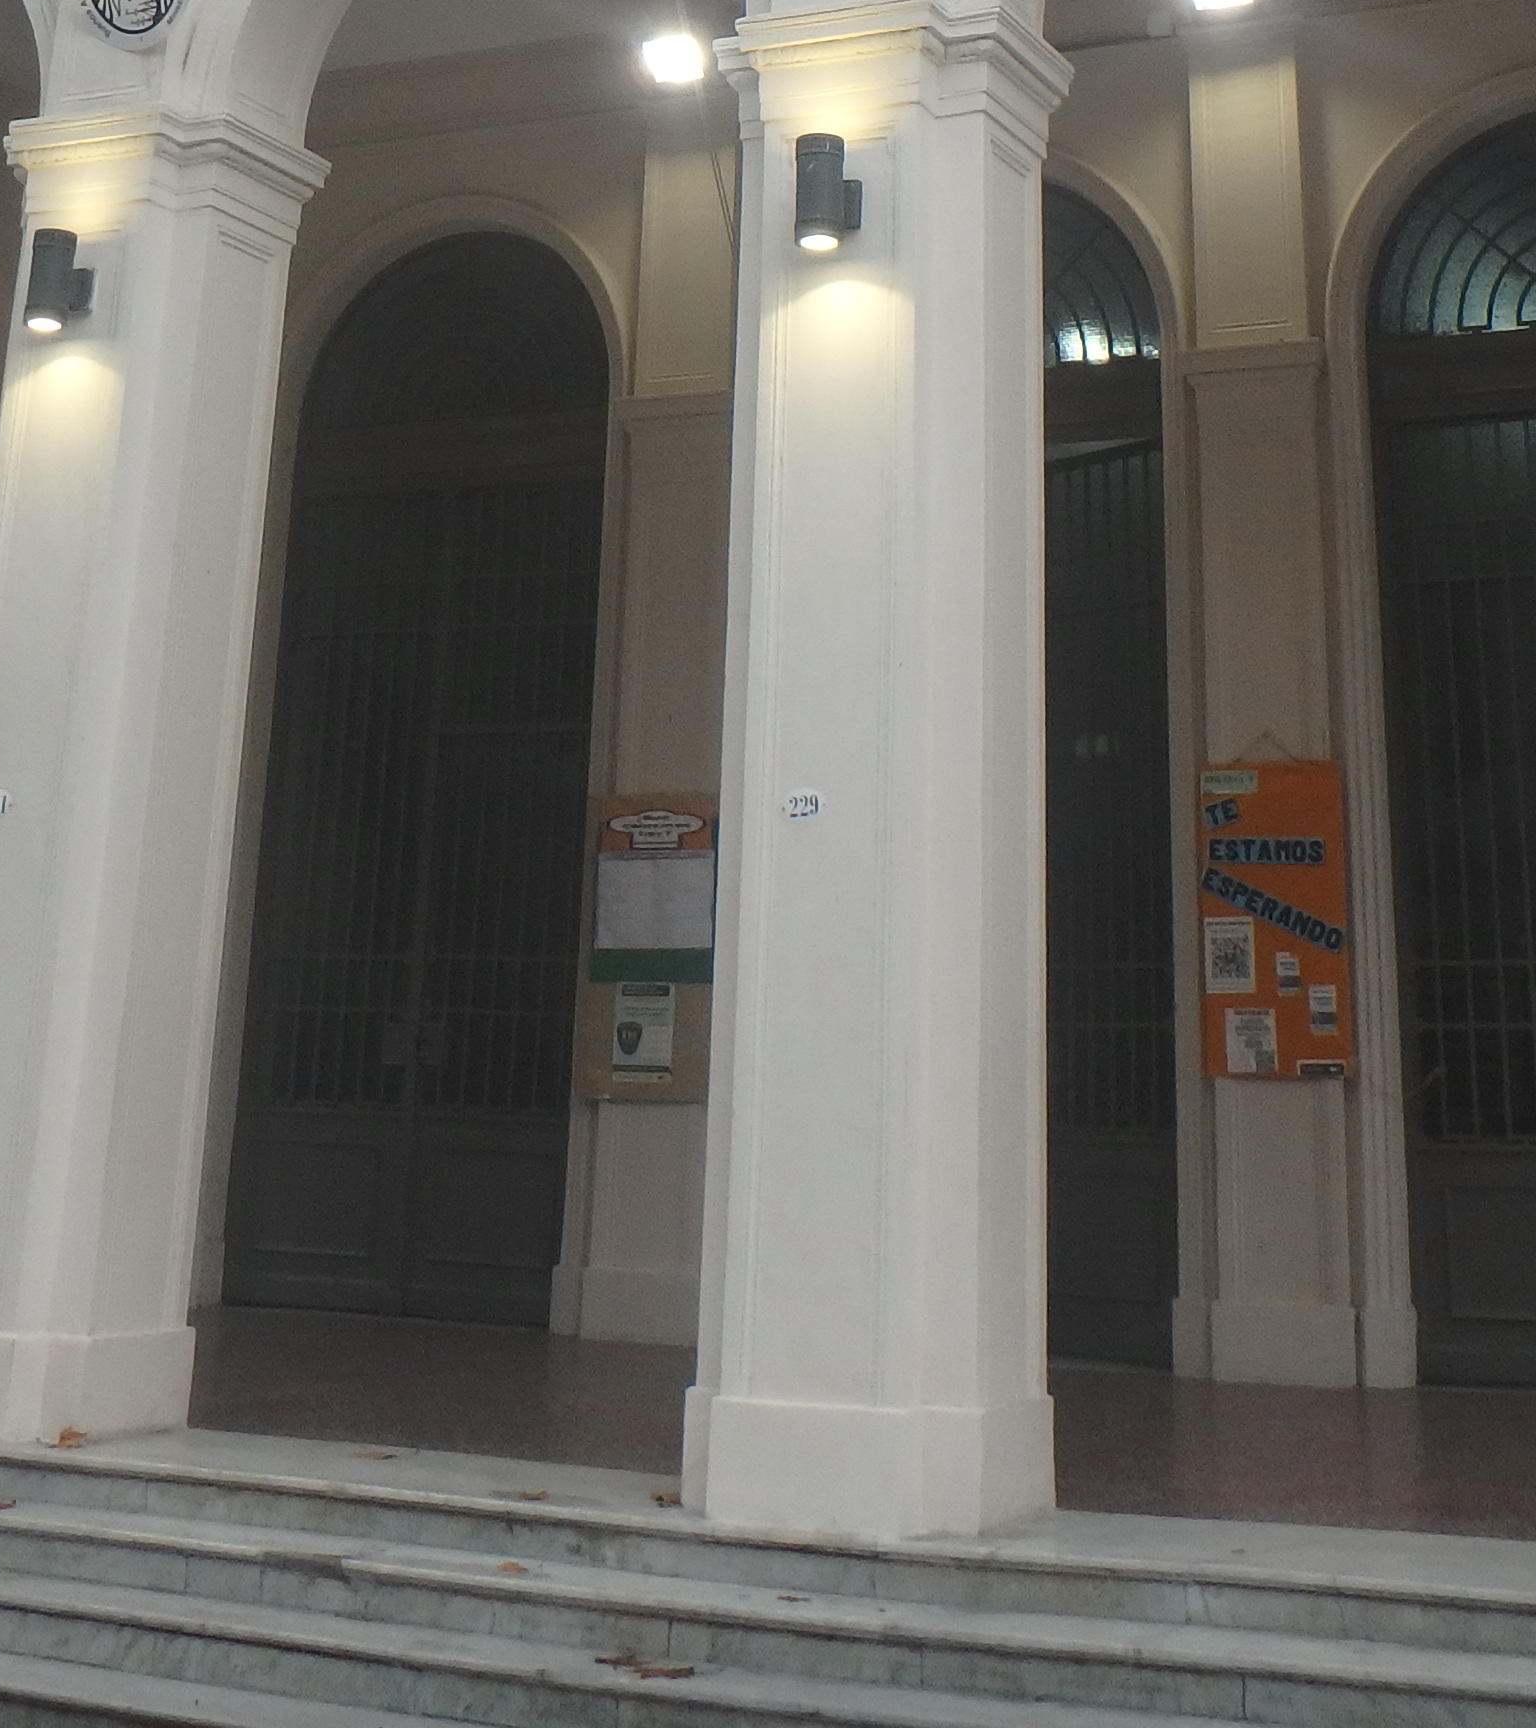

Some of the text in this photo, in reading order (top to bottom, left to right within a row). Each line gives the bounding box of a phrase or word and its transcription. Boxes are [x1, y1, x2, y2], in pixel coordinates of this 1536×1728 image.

[85, 8, 112, 38] Buenos
[788, 794, 819, 818] 229
[1205, 798, 1239, 825] TE
[1209, 838, 1324, 863] ESTAMOS
[1202, 867, 1343, 950] ESPERANDO
